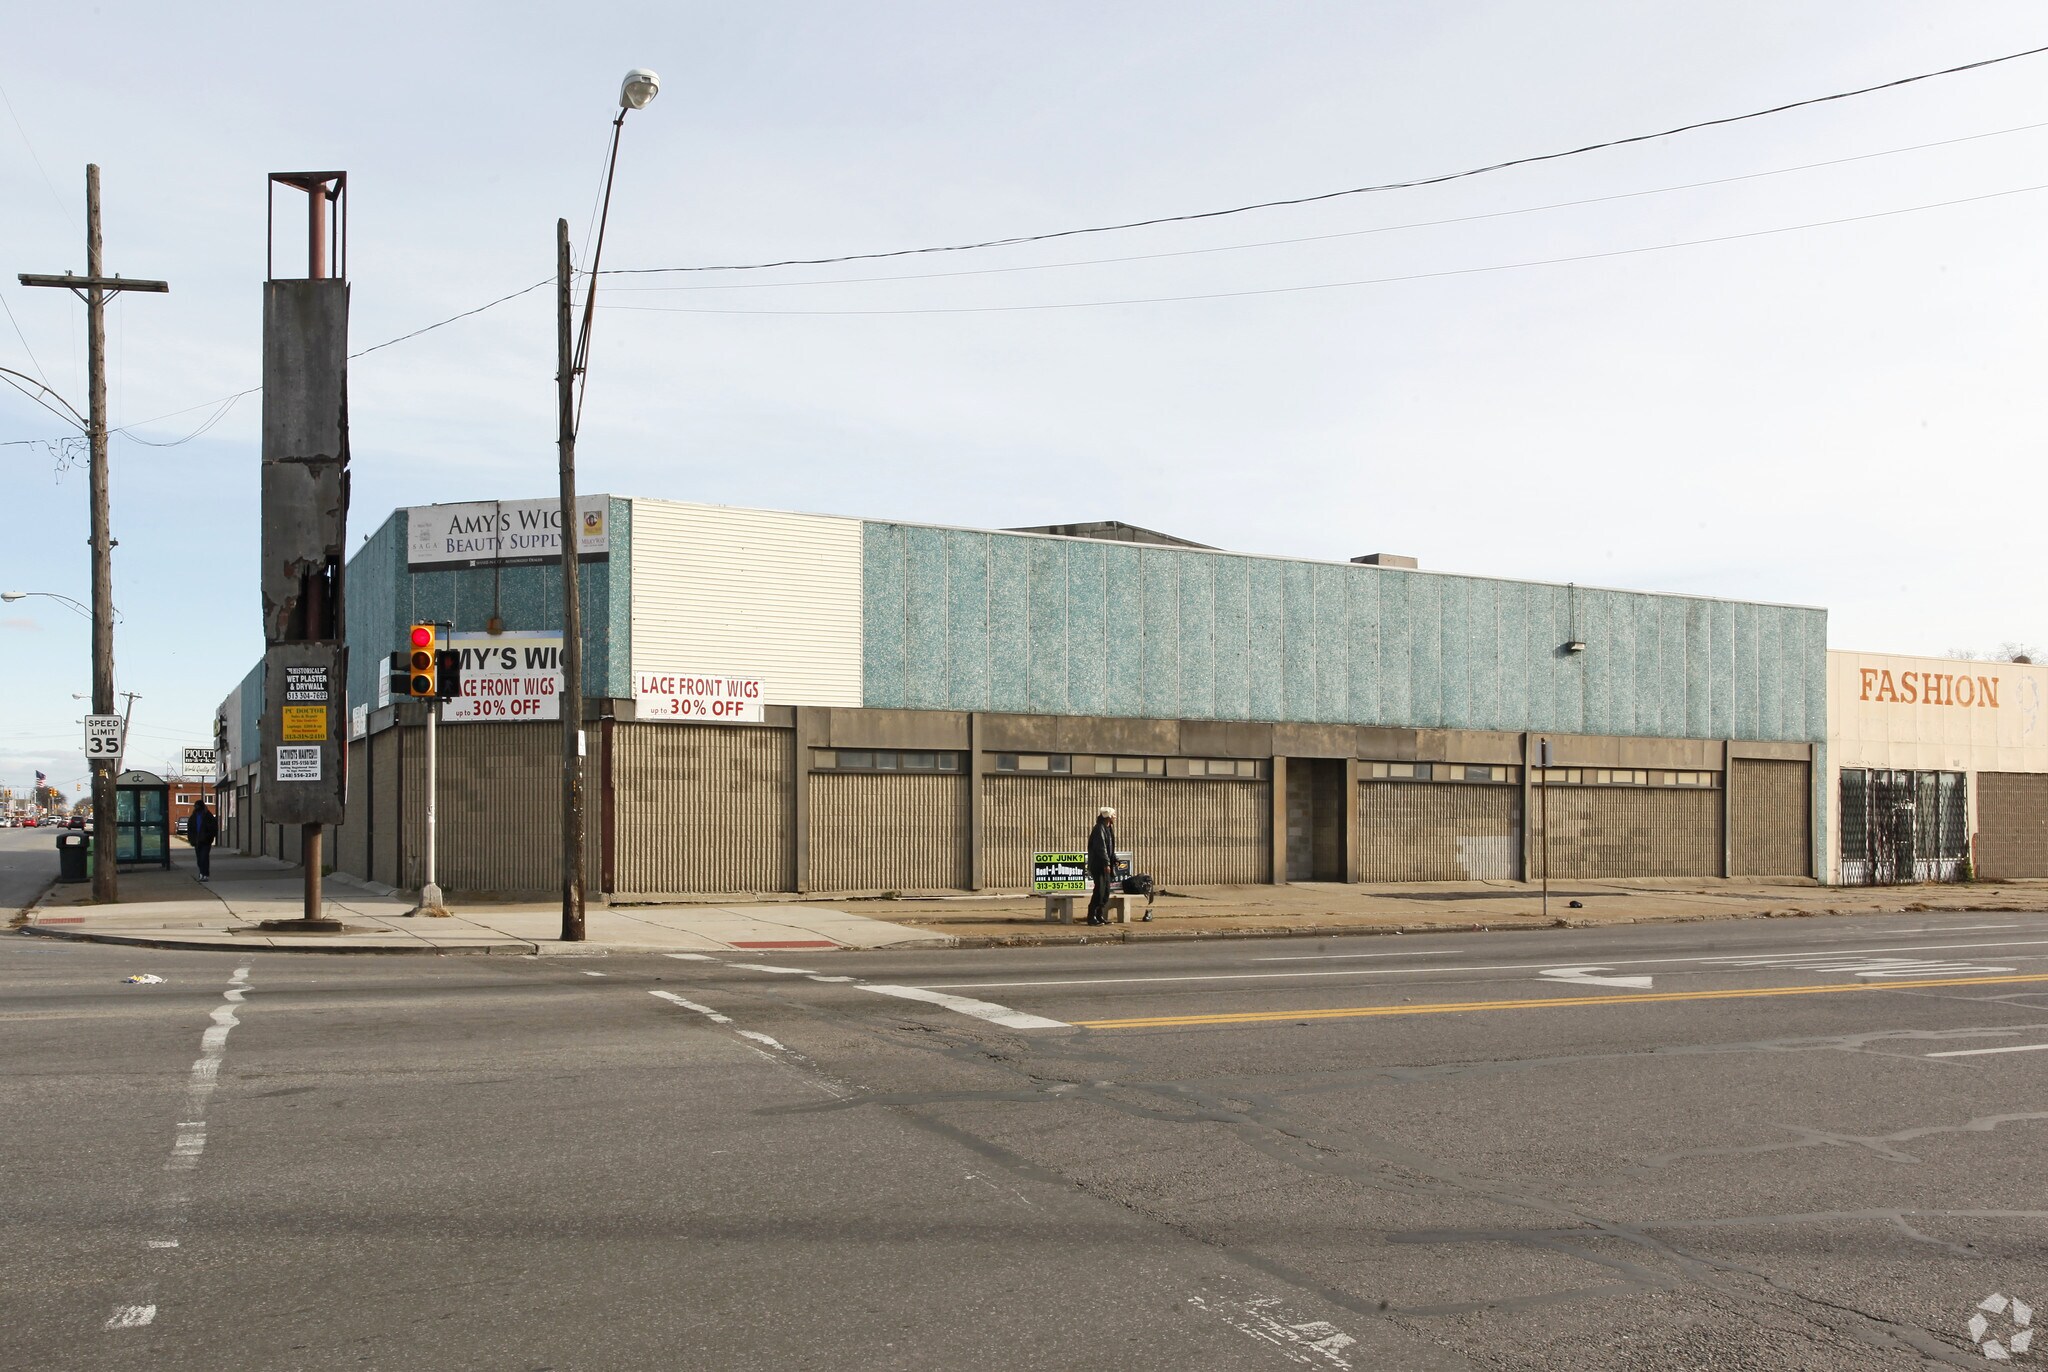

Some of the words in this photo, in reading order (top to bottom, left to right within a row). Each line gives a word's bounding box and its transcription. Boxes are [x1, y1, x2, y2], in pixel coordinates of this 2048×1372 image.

[448, 509, 511, 535] AMY'S
[446, 537, 505, 554] BEAUTY
[440, 647, 517, 671] MY'S
[524, 647, 564, 670] WI
[459, 678, 477, 698] CE
[480, 678, 520, 697] FRONT
[524, 677, 554, 696] WIGS
[641, 676, 675, 695] LACE
[679, 678, 722, 697] FRONT
[727, 680, 759, 698] WIGS
[1859, 667, 2000, 708] FASHION
[473, 701, 506, 716] 30%
[511, 699, 541, 715] OFF
[671, 698, 707, 716] 30%
[712, 700, 744, 716] OFF
[88, 719, 119, 727] SPEED
[89, 737, 119, 753] 35
[280, 749, 297, 759] ACTIVISTS
[1035, 854, 1053, 862] GOT
[1056, 854, 1083, 862] JUNK?
[1036, 882, 1083, 890] 313-357-1352
